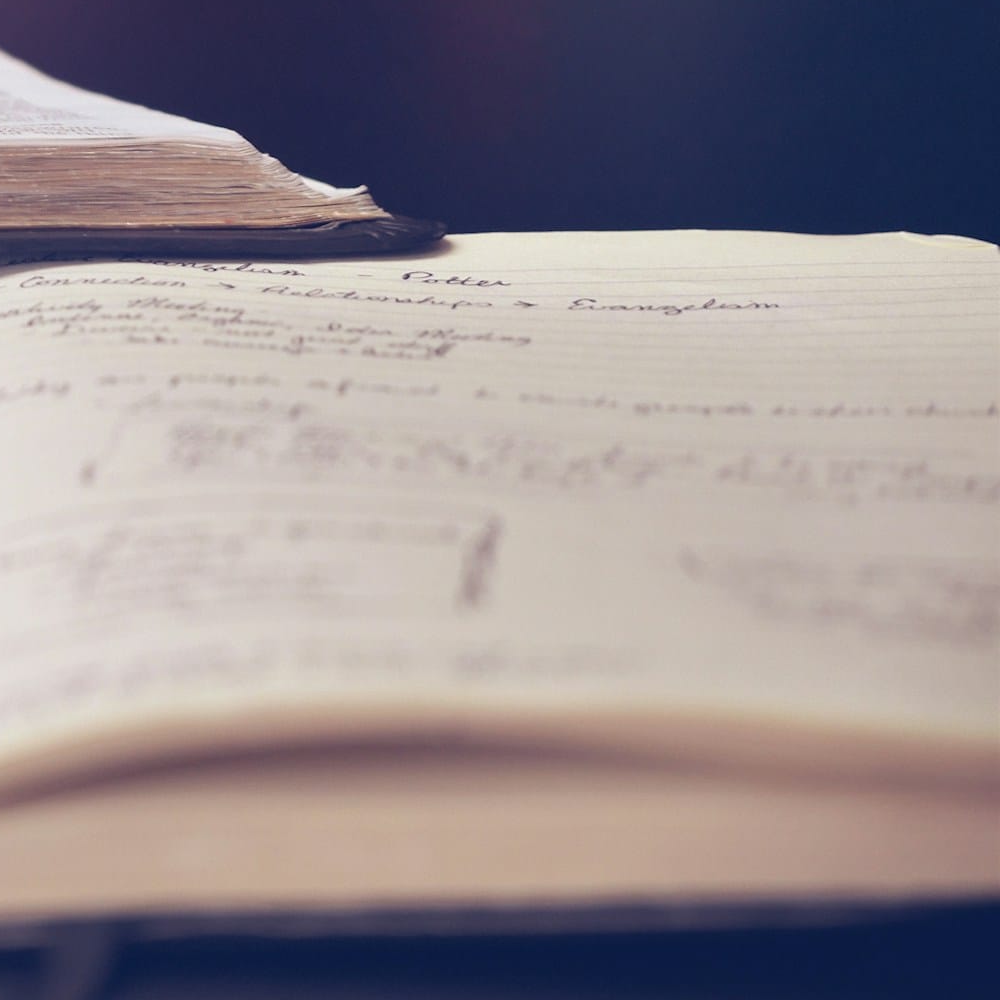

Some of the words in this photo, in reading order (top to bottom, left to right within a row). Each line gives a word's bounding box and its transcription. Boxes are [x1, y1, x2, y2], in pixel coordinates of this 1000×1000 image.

[401, 270, 512, 288] Potter
[18, 275, 188, 290] Connection
[259, 284, 494, 310] Relationships
[567, 297, 781, 316] Evangelism
